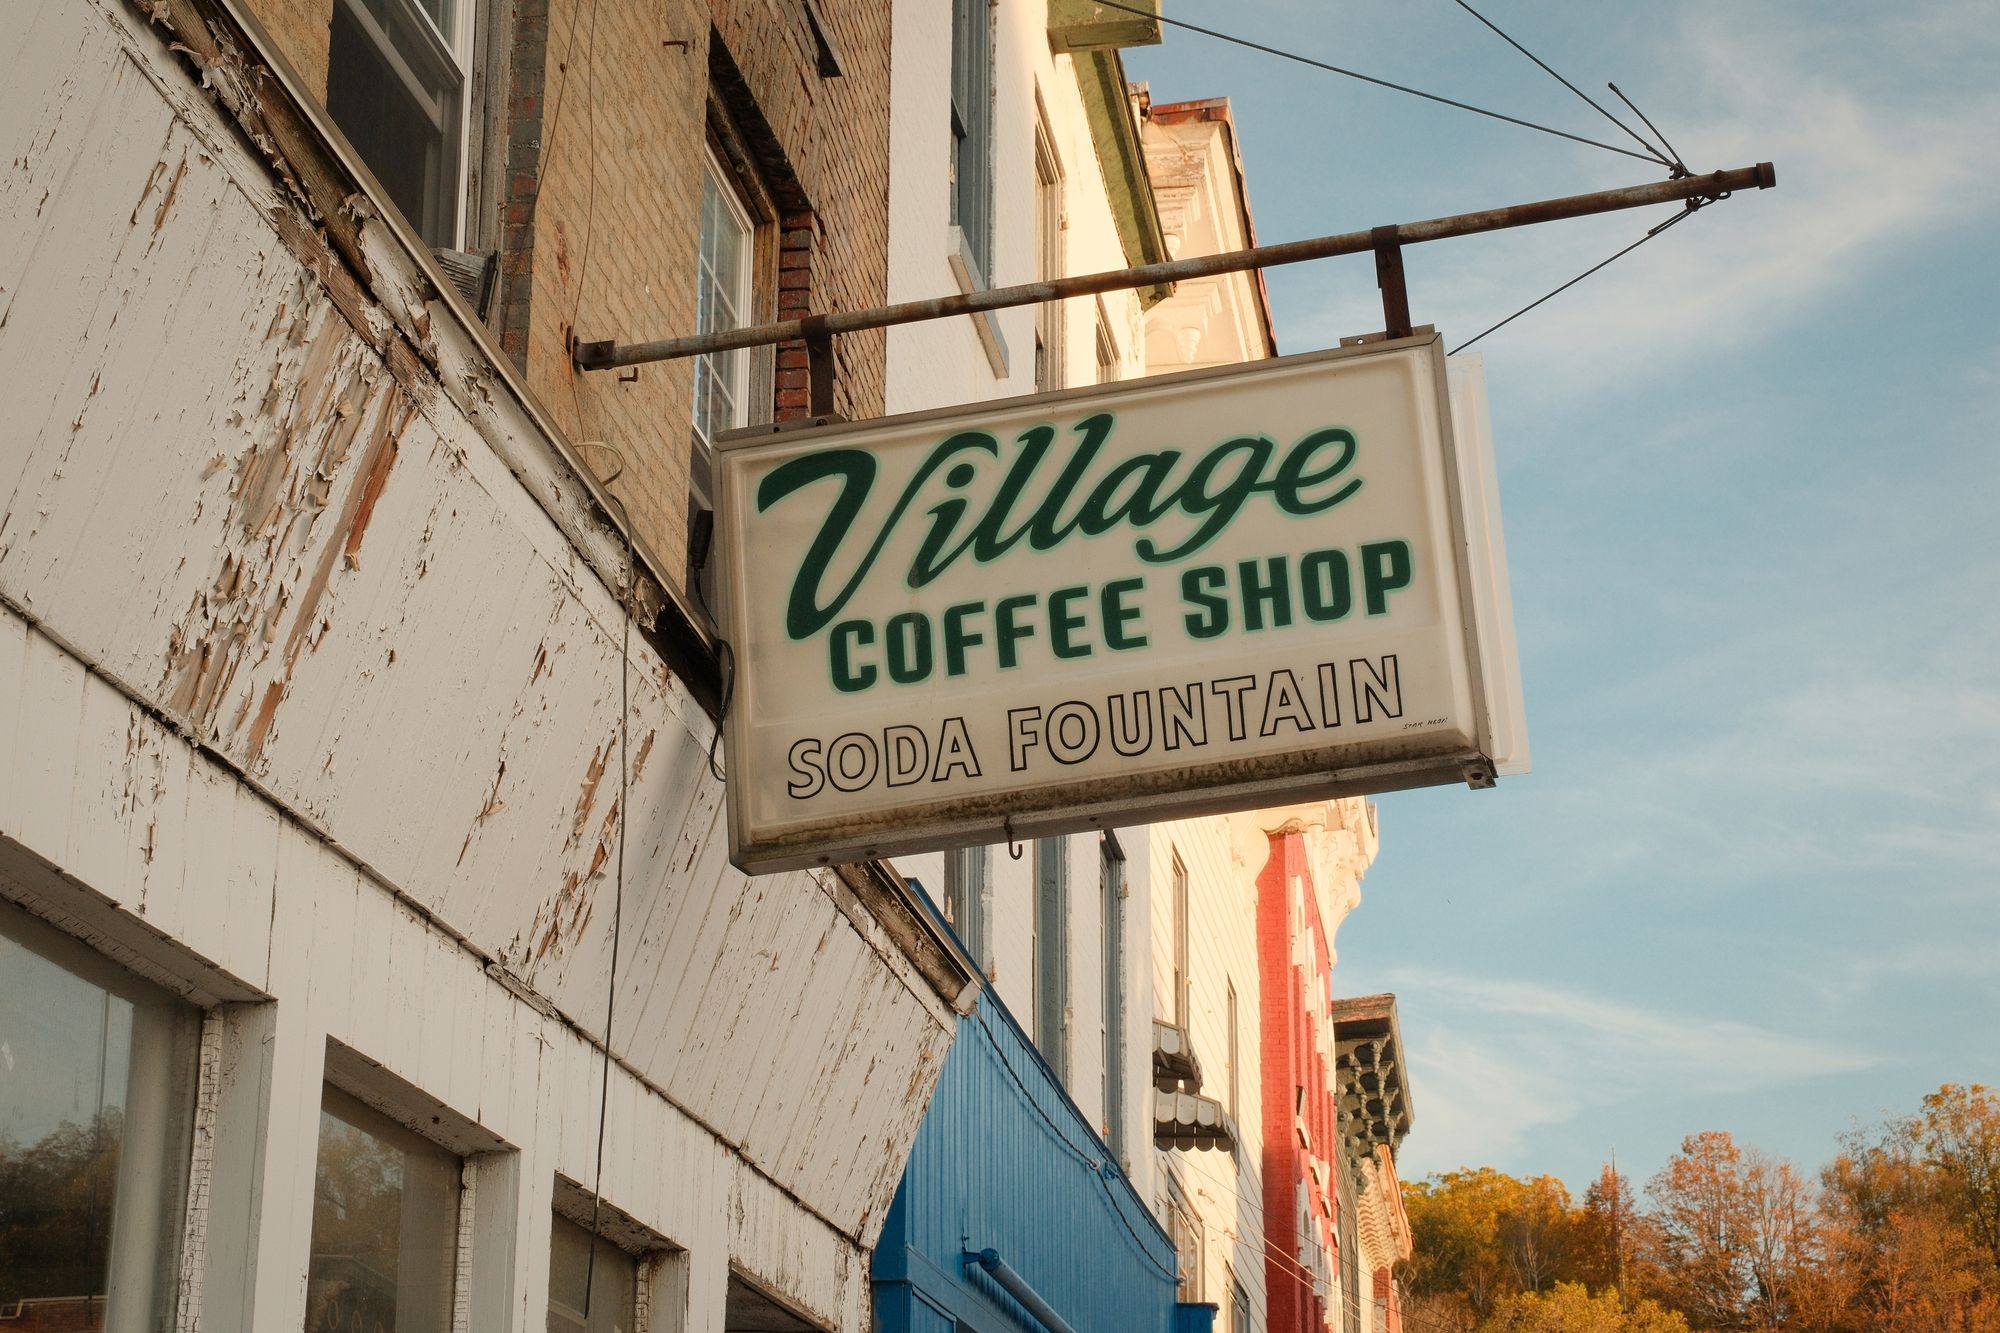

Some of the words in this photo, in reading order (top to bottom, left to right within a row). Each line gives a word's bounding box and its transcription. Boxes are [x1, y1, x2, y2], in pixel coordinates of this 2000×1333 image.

[756, 412, 1363, 641] Village
[829, 576, 1148, 693] COFFEE
[1182, 539, 1412, 640] SHOP
[787, 716, 982, 799] SODA
[1008, 654, 1403, 772] FOUNTAIN
